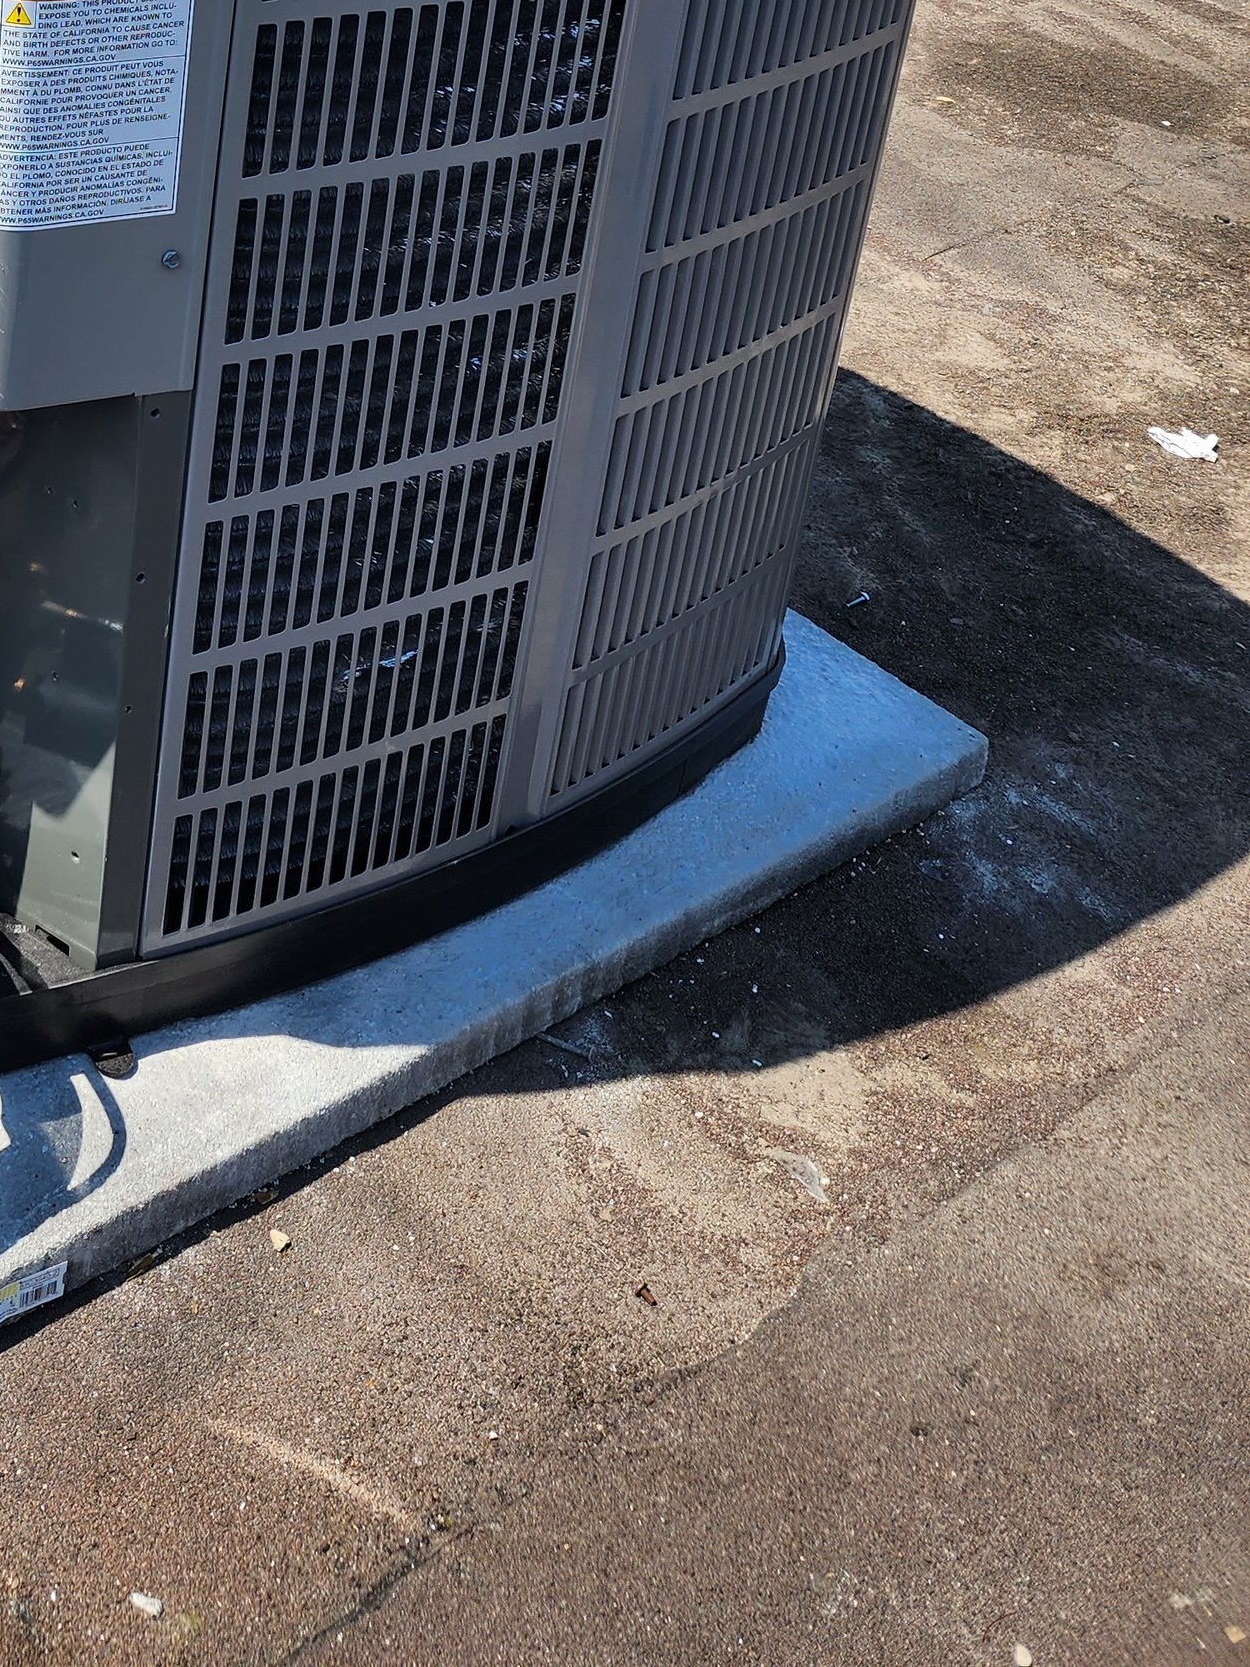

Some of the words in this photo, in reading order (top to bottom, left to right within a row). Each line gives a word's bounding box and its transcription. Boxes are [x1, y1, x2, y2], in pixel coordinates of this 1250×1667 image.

[38, 1, 80, 11] WARNING:
[81, 0, 100, 8] THIS
[38, 11, 71, 20] EXPOSE
[91, 8, 103, 16] TO
[103, 5, 150, 15] CHEMICALS
[150, 2, 176, 11] INCLU-
[38, 21, 59, 30] DING
[84, 17, 112, 26] WHICH
[112, 16, 129, 24] ARE
[131, 13, 160, 22] KNOWN
[62, 27, 111, 37] CALIFORNIA
[123, 24, 151, 32] CAUSE
[152, 20, 184, 30] CANCER
[3, 40, 21, 48] AND
[49, 38, 87, 48] DEFECTS
[100, 34, 128, 44] OTHER
[130, 29, 176, 41] REPRODUC-
[3, 49, 20, 58] TIVE
[72, 46, 96, 54] MORE
[96, 41, 150, 52] INFORMATION
[151, 40, 163, 48] GO
[165, 38, 178, 47] TO:
[2, 53, 116, 67] WWW.P65WARNINGS.CA.GOV
